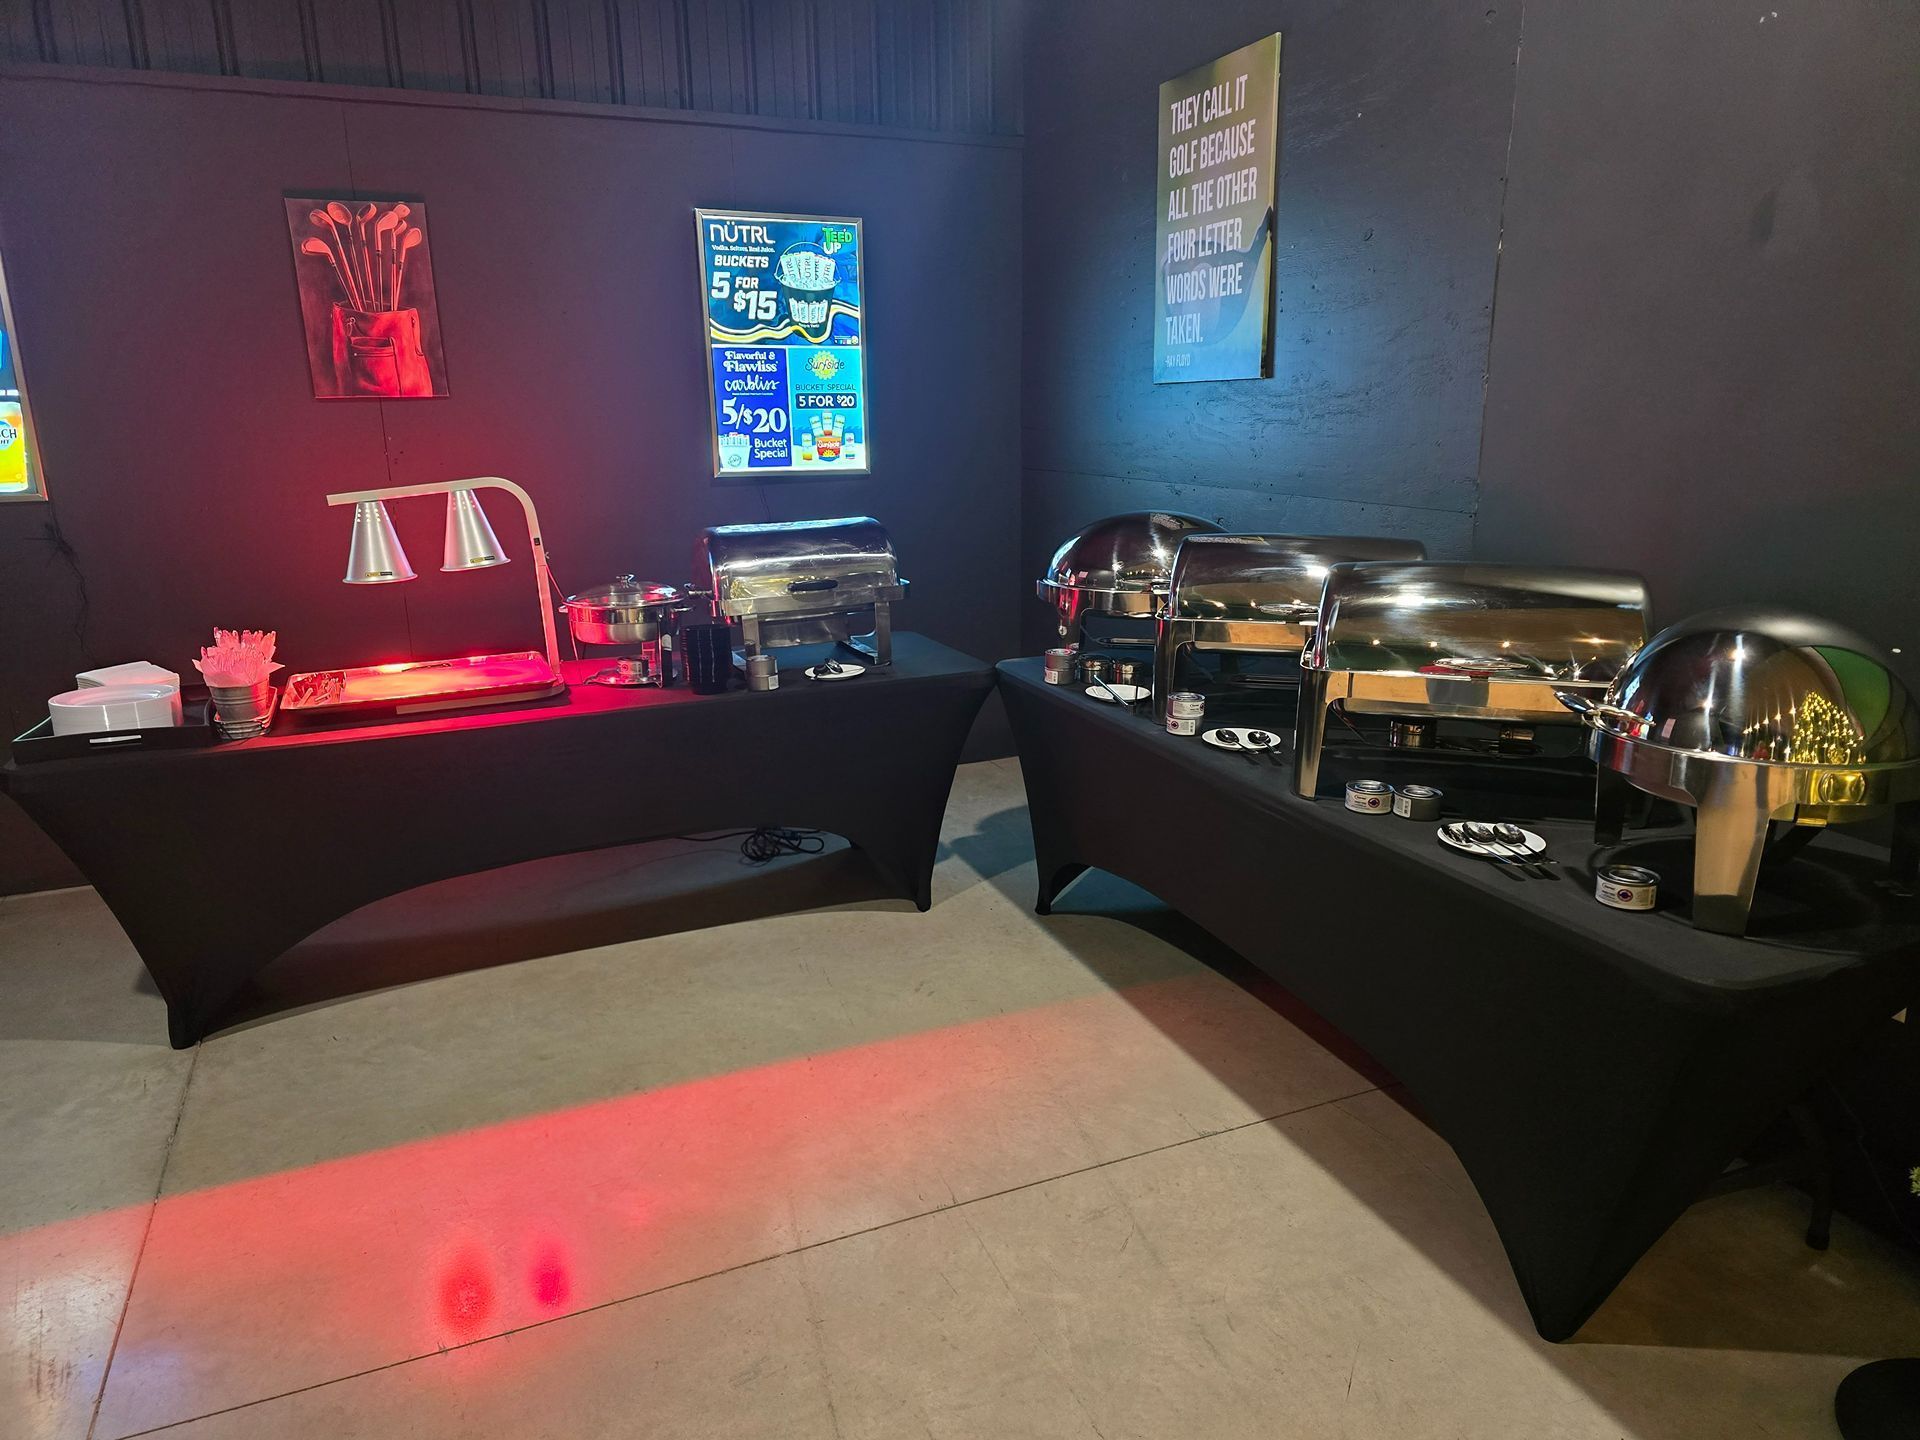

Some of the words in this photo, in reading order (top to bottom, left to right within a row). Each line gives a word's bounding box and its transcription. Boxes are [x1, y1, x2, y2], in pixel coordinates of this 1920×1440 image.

[1171, 93, 1201, 135] THEY
[1202, 81, 1232, 123] CALL
[1235, 74, 1248, 112] IT
[1169, 139, 1198, 178] GOLF
[1200, 119, 1256, 170] BECAUSE
[1168, 187, 1188, 222] ALL
[1192, 179, 1214, 216] THE
[1216, 167, 1258, 209] OTHER
[710, 221, 776, 244] NÜTRL
[1168, 228, 1195, 264] FOUR
[1199, 217, 1243, 257] LETTER
[714, 255, 769, 268] BUCKETS
[711, 271, 731, 299] 5
[735, 277, 759, 289] FOR
[1167, 269, 1206, 305] WORDS
[1209, 262, 1244, 298] WERE
[733, 289, 778, 321] $15
[1166, 313, 1204, 345] TAKEN.
[724, 351, 767, 360] Flavorful
[768, 351, 776, 360] &
[805, 357, 845, 371] Surfside
[799, 395, 806, 407] 5
[808, 395, 835, 407] FOR
[836, 394, 855, 407] $20
[754, 437, 787, 448] Bucket
[754, 448, 788, 460] Special
